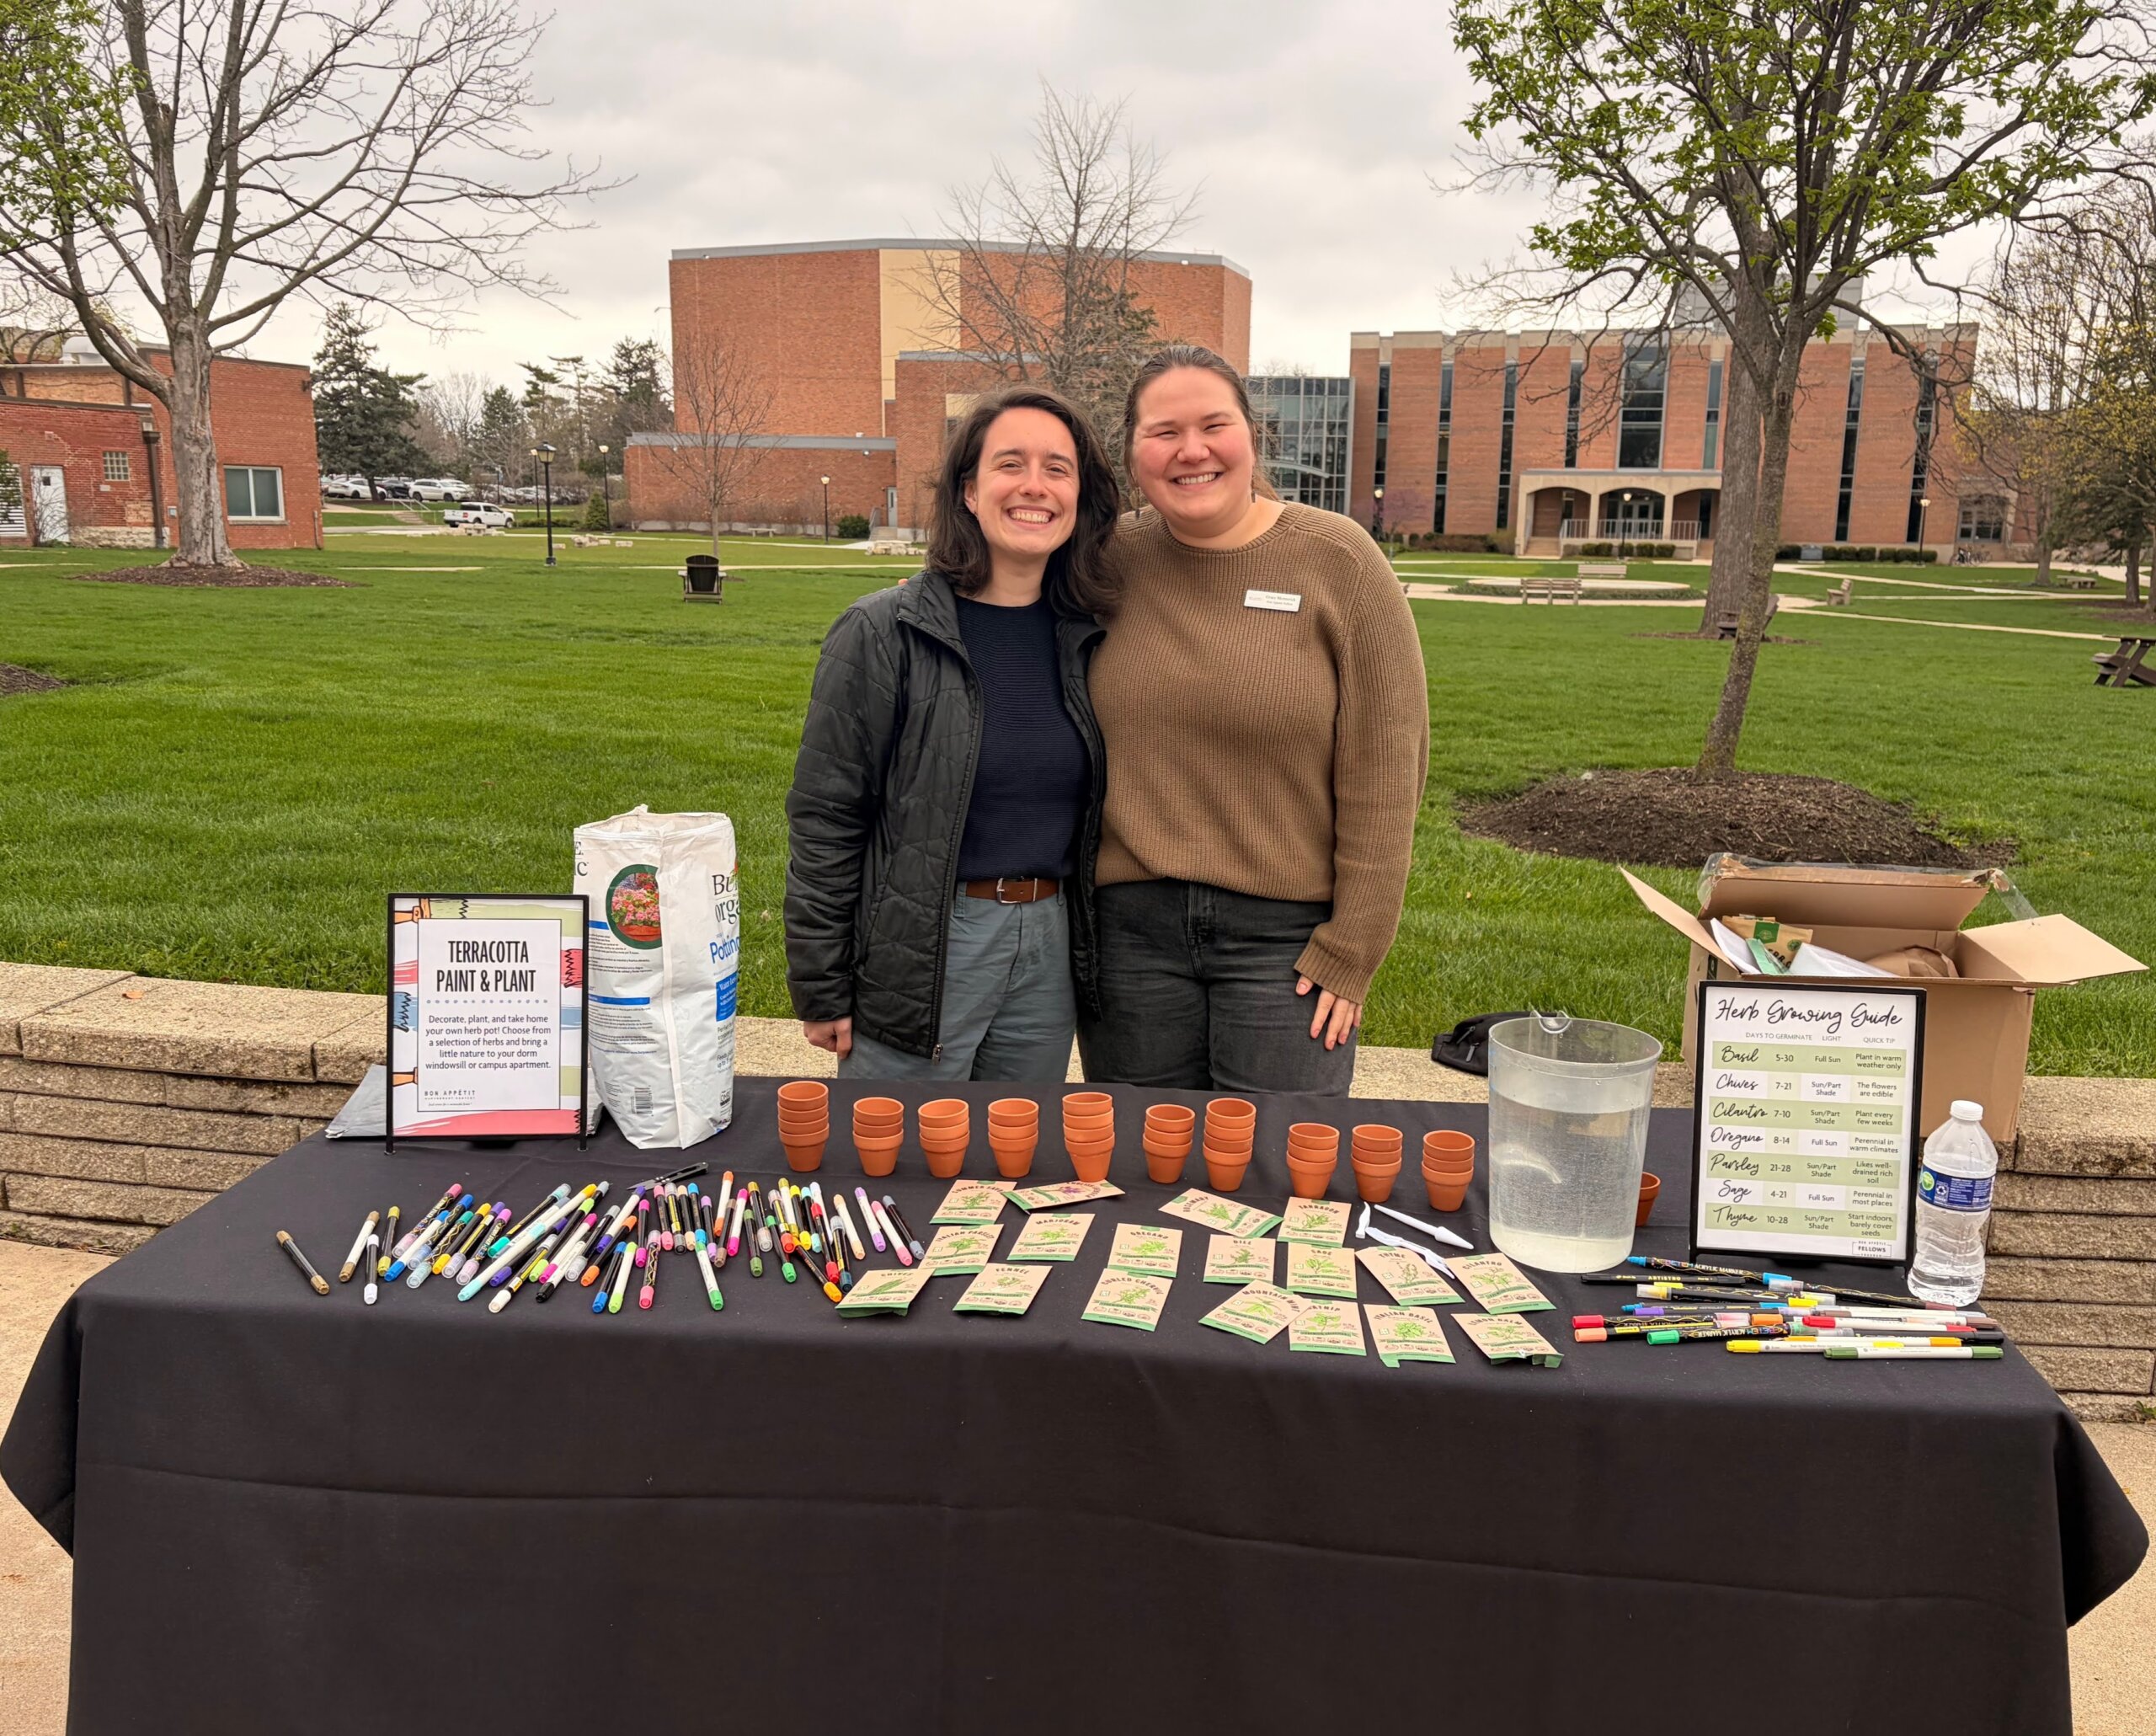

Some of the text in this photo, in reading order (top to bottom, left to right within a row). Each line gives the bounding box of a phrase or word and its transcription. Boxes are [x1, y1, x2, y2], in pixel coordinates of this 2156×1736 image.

[448, 941, 529, 963] TERRACOTTA
[437, 969, 536, 991] PAINT & PLANT
[429, 1015, 466, 1023] Decorate,
[468, 1015, 489, 1025] plant,
[1716, 997, 1903, 1034] Herb Growing Guide
[425, 1028, 444, 1037] your
[464, 1026, 482, 1034] herb
[484, 1027, 499, 1036] pot!
[502, 1026, 531, 1034] Choose
[435, 1038, 470, 1046] selection
[522, 1038, 542, 1048] bring
[497, 1051, 515, 1060] your
[1721, 1045, 1758, 1062] Basil
[1776, 1054, 1794, 1062] 5-30
[425, 1060, 466, 1069] windowsill
[510, 1061, 551, 1071] apartment.
[1716, 1074, 1758, 1090] Chives
[1812, 1082, 1841, 1090] Sun/Part
[1713, 1102, 1768, 1119] Cilantro
[1710, 1127, 1764, 1150] Oregano
[1710, 1153, 1758, 1176] Parsley
[1806, 1162, 1836, 1172] Sun/Part
[1718, 1180, 1752, 1202] Sage
[1713, 1206, 1758, 1226] Thyme
[1767, 1215, 1788, 1224] 10-28
[1865, 1215, 1894, 1223] indoors,
[1850, 1221, 1871, 1230] barely
[1462, 1260, 1502, 1270] CILANTRO
[1694, 1263, 1718, 1272] ACRYLIC
[1719, 1266, 1744, 1275] MARKER
[1242, 1290, 1288, 1300] MOUNTAIN
[1408, 1312, 1433, 1323] BASIL
